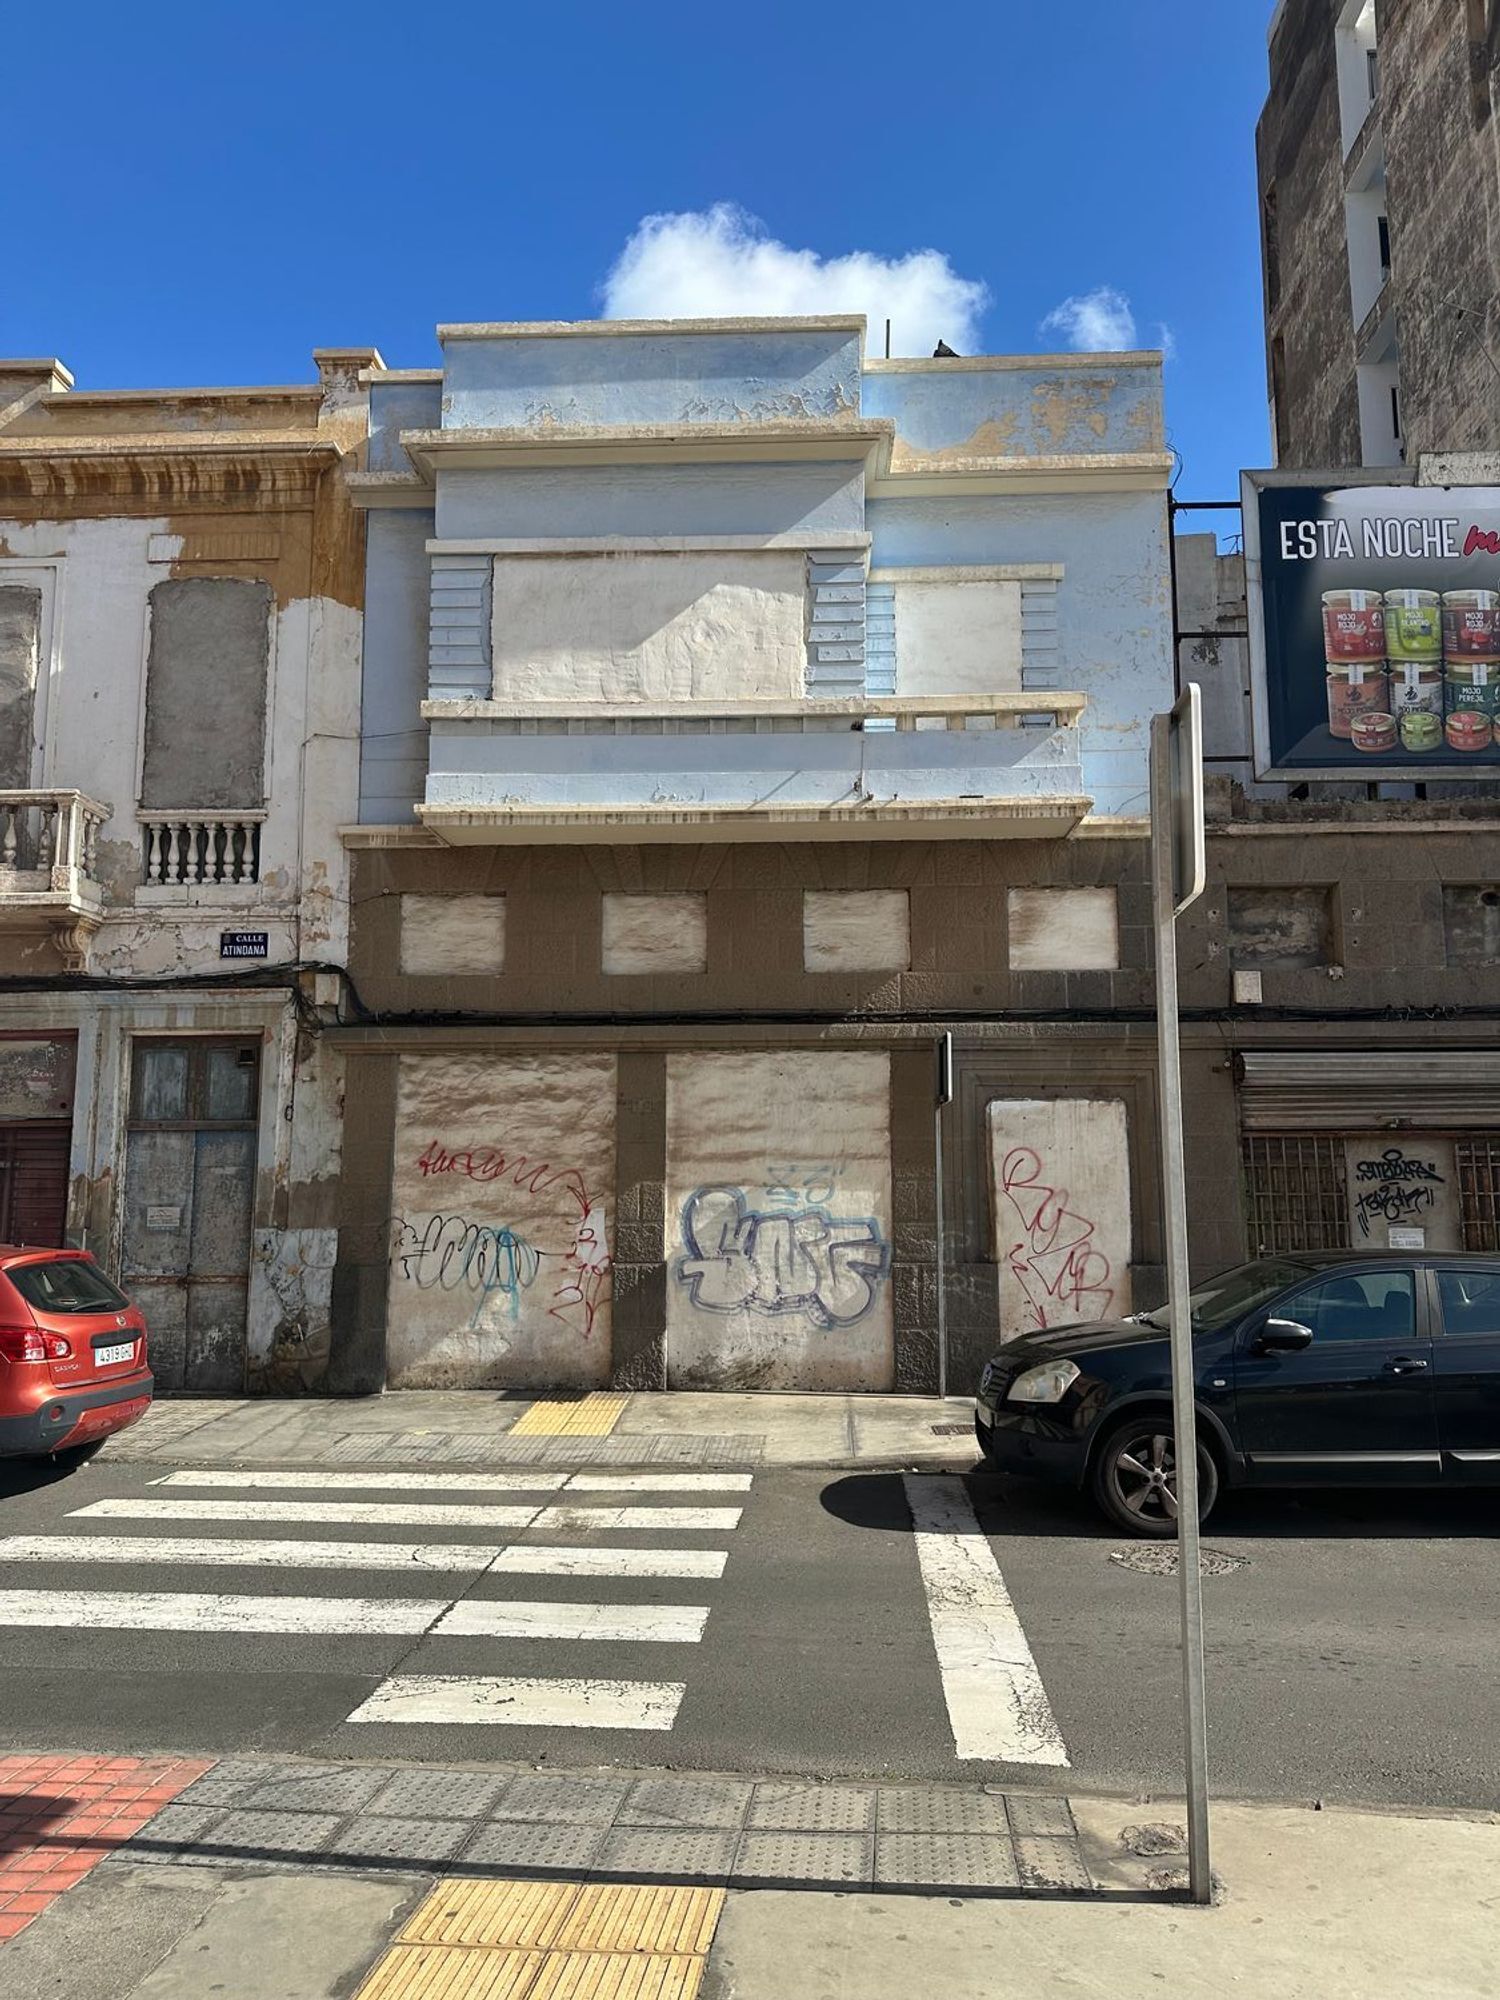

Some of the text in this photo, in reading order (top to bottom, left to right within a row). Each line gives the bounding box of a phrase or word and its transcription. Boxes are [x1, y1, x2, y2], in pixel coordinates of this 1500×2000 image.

[1279, 519, 1355, 560] ESTA
[1362, 518, 1460, 558] NOCHE
[1337, 613, 1356, 621] MOJO
[1465, 612, 1484, 620] MOJO
[1462, 687, 1481, 695] MOJO
[236, 934, 264, 943] CALLE
[222, 945, 265, 956] ATINDANA
[100, 1347, 119, 1362] 4319
